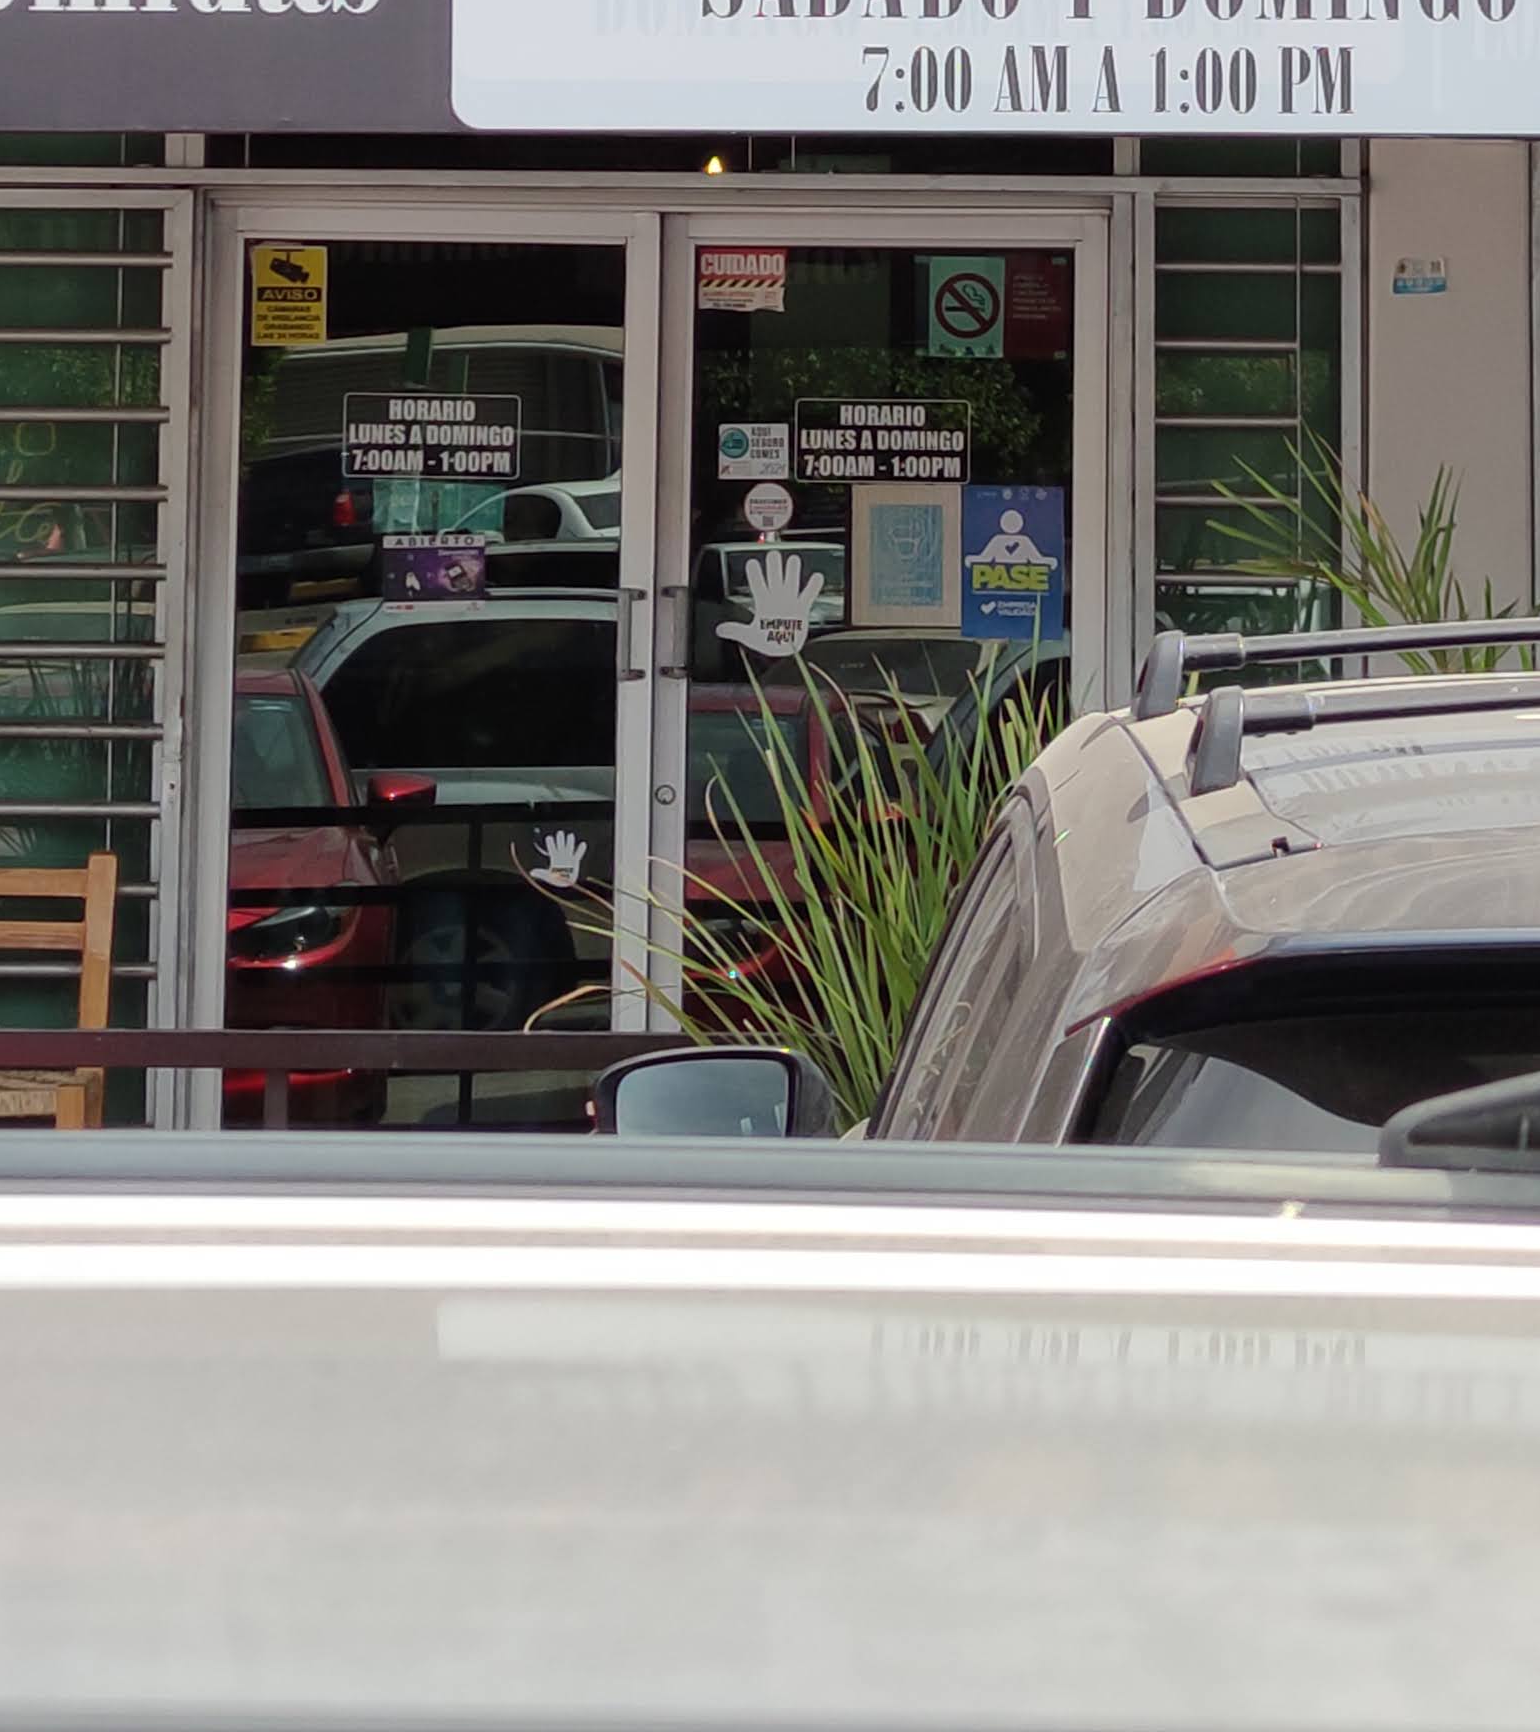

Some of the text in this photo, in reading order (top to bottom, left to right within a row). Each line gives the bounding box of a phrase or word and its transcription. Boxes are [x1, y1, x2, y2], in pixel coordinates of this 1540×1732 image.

[862, 45, 1353, 114] 7:00 AM A 1:00 PM
[700, 253, 784, 275] CUIDADO
[262, 288, 318, 301] AVISO
[389, 399, 476, 422] HORARIO
[840, 404, 926, 427] HORARIO
[349, 423, 515, 447] LUNES A DOMINGO
[801, 428, 965, 452] LUNES A DOMINGO
[352, 449, 424, 473] 7:00AM
[804, 454, 875, 477] 7:00AM
[891, 455, 961, 478] 1:00PM
[394, 536, 474, 546] ABIERTO
[972, 564, 1049, 590] PASE
